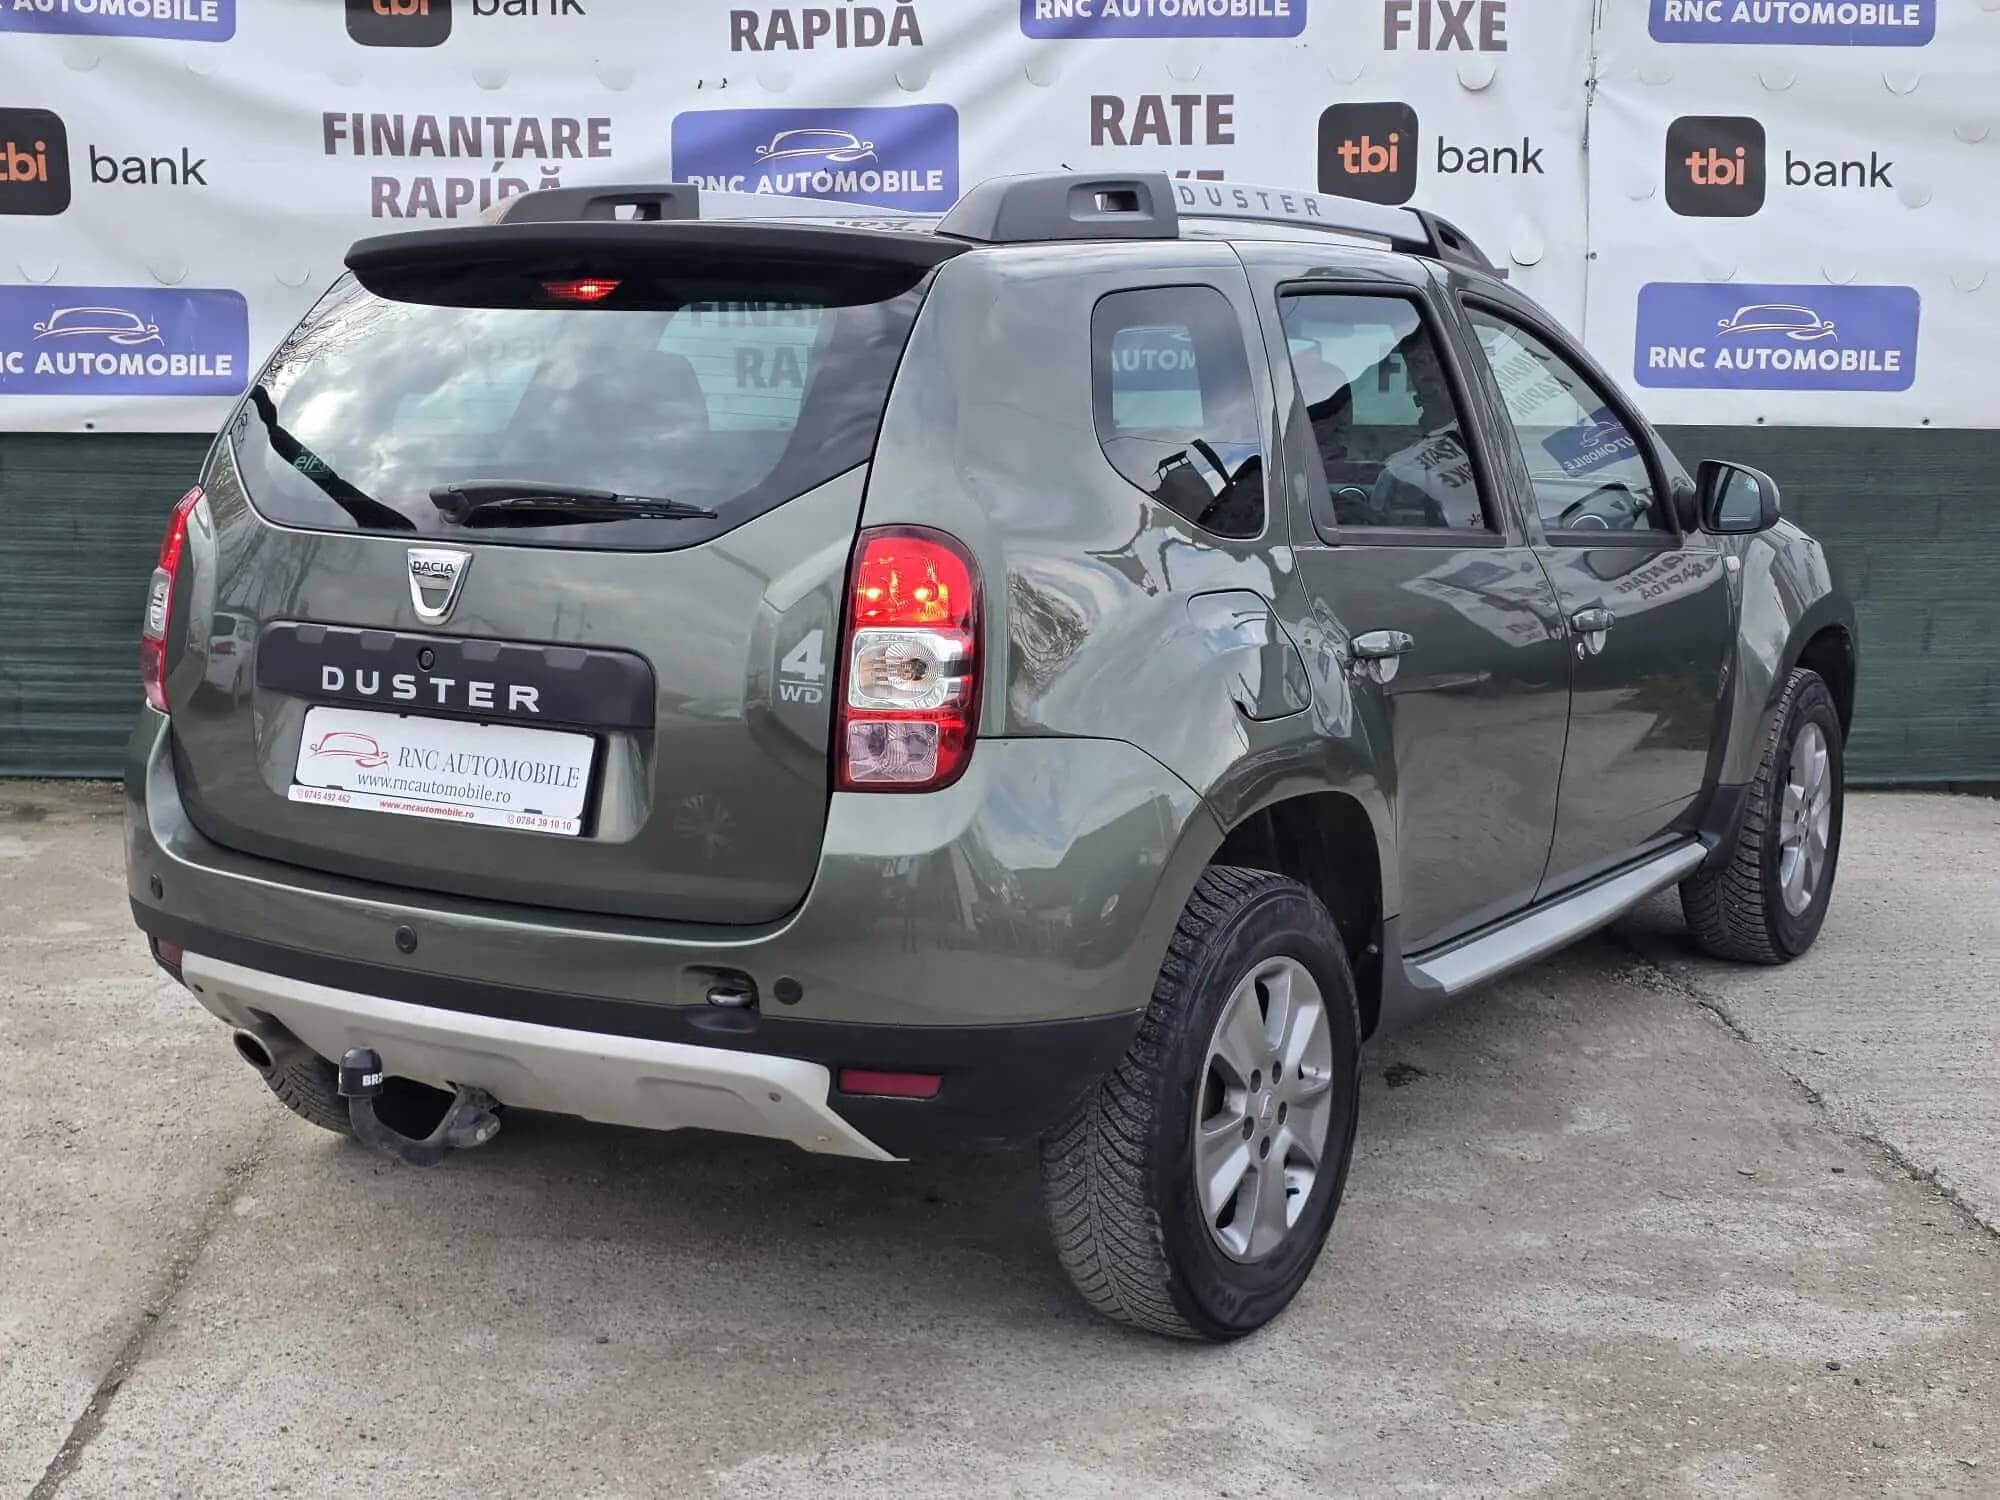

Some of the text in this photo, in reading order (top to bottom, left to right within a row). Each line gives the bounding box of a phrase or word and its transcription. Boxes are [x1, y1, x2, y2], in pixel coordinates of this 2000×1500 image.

[1034, 0, 1290, 20] RNC AUTOMOBILE
[1383, 0, 1508, 51] FIXE
[1664, 2, 1920, 26] RNC AUTOMOBILE
[1090, 94, 1235, 146] RATE
[89, 144, 208, 186] bank
[1337, 132, 1544, 175] tbi bank
[1685, 146, 1894, 189] tbi bank
[756, 170, 943, 194] AUTOMOBILE
[1179, 186, 1322, 217] DUSTER
[34, 352, 233, 377] AUTOMOBILE
[1649, 347, 1901, 372] RNC AUTOMOBILE
[413, 560, 455, 573] DACIA
[781, 629, 826, 681] 4
[320, 664, 540, 714] DUSTER
[779, 684, 824, 704] WD
[397, 746, 581, 789] RNC AUTOMOBILE
[356, 773, 512, 804] www.rncautomobile.ro
[379, 799, 476, 819] www.rncautomobile.ro
[516, 815, 536, 826] 0784
[550, 818, 560, 829] 10
[563, 820, 572, 831] 10
